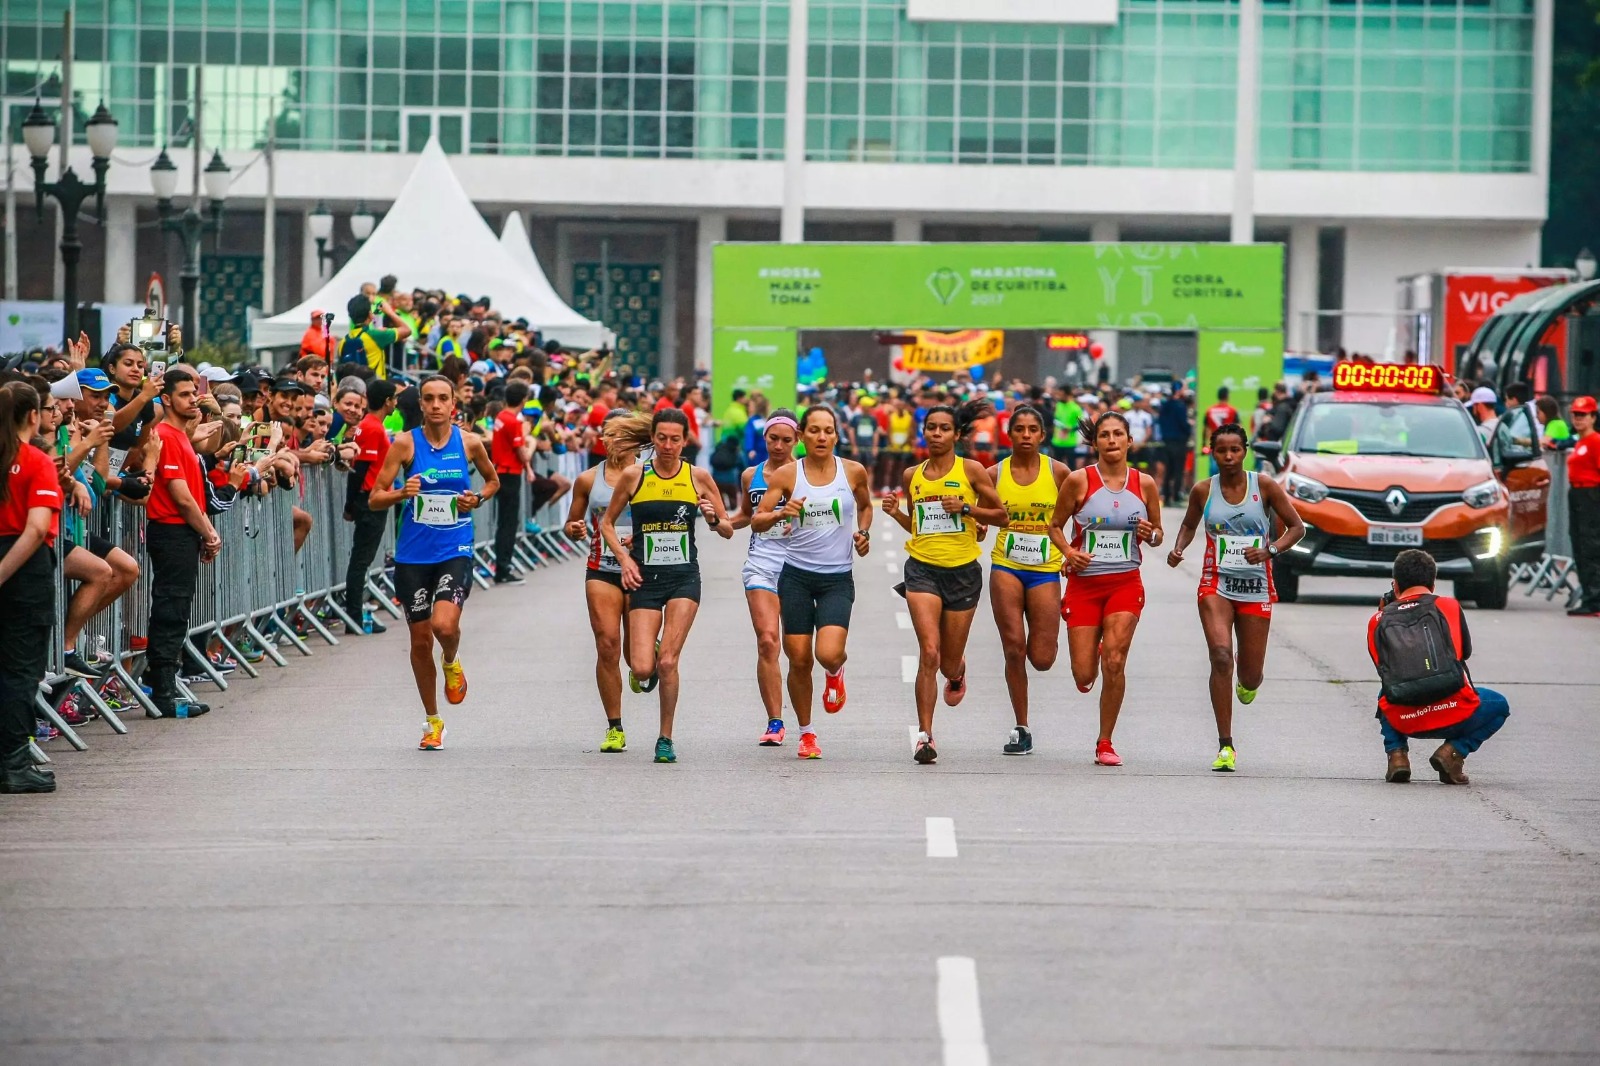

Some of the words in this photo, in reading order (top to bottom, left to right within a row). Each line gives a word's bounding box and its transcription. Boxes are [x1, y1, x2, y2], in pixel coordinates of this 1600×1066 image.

[970, 266, 1057, 278] MARATONA
[1172, 273, 1225, 285] CORRA
[971, 280, 990, 291] DE
[996, 280, 1067, 291] CURITIBA
[1172, 287, 1244, 299] CURITIBA
[770, 294, 812, 304] TONA
[971, 293, 1004, 306] 2017
[1336, 363, 1434, 389] 00:00:00
[804, 509, 834, 518] NOEME
[922, 513, 954, 521] PATRICIA
[641, 522, 662, 532] DIONE
[654, 545, 680, 553] DIONE
[1010, 544, 1044, 553] ADRIANA
[1225, 584, 1262, 594] SPORTS
